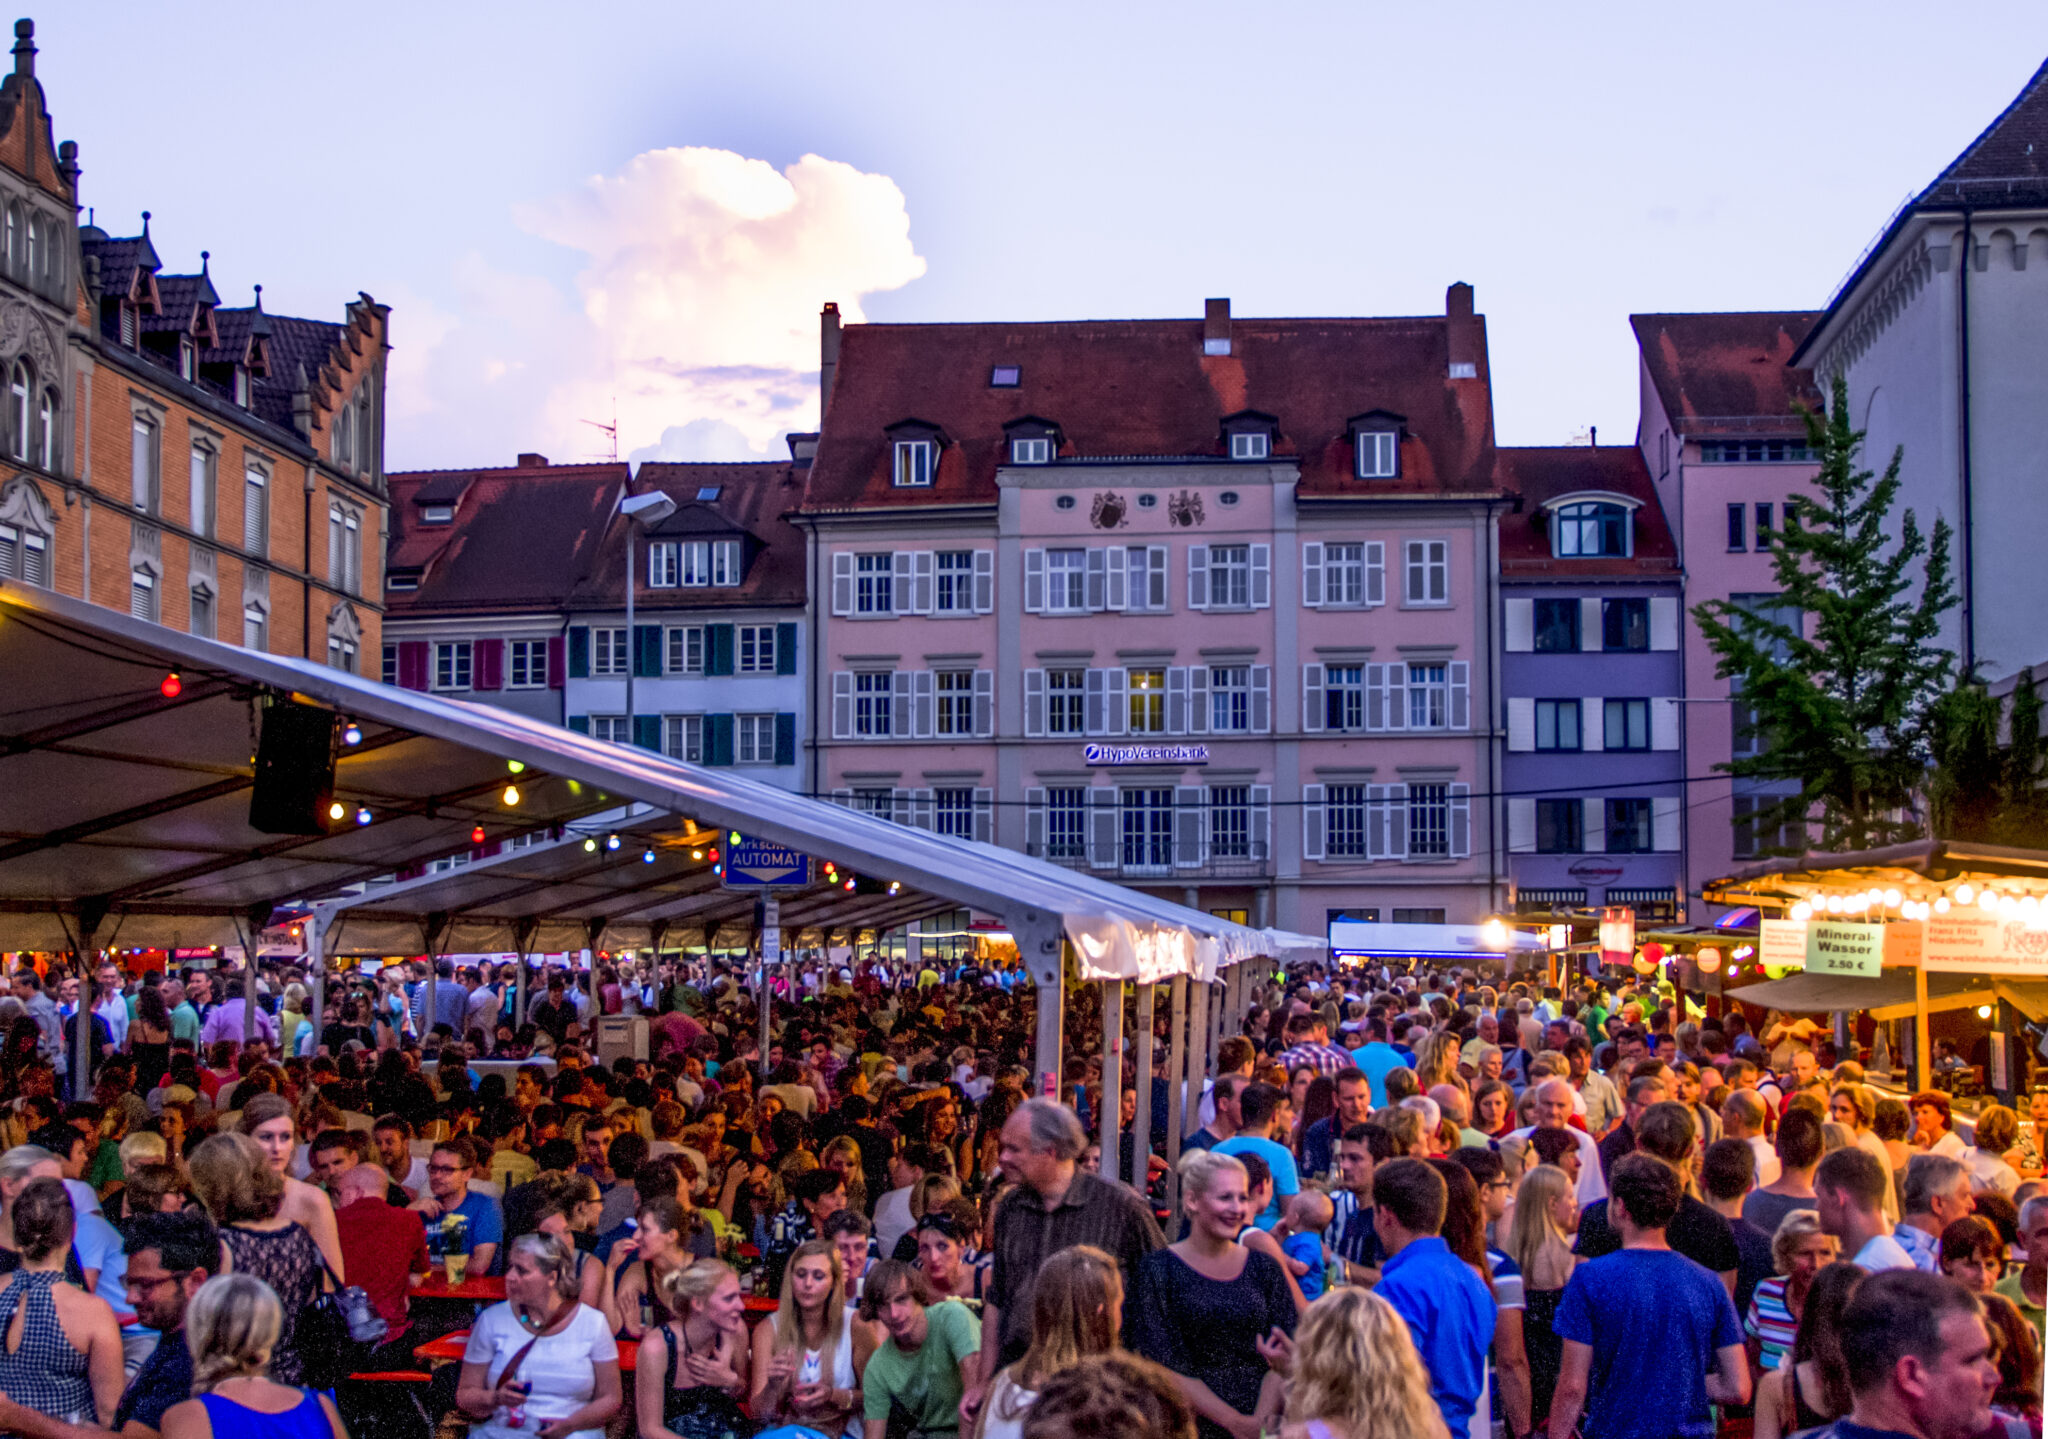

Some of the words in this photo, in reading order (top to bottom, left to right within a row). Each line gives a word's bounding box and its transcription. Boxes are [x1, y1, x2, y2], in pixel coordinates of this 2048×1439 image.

[1101, 745, 1208, 763] HypoVereinsbank
[731, 852, 800, 866] AUTOMAT
[1816, 928, 1876, 941] Mineral-
[1818, 941, 1872, 955] Wasser
[1828, 959, 1853, 969] 2.50
